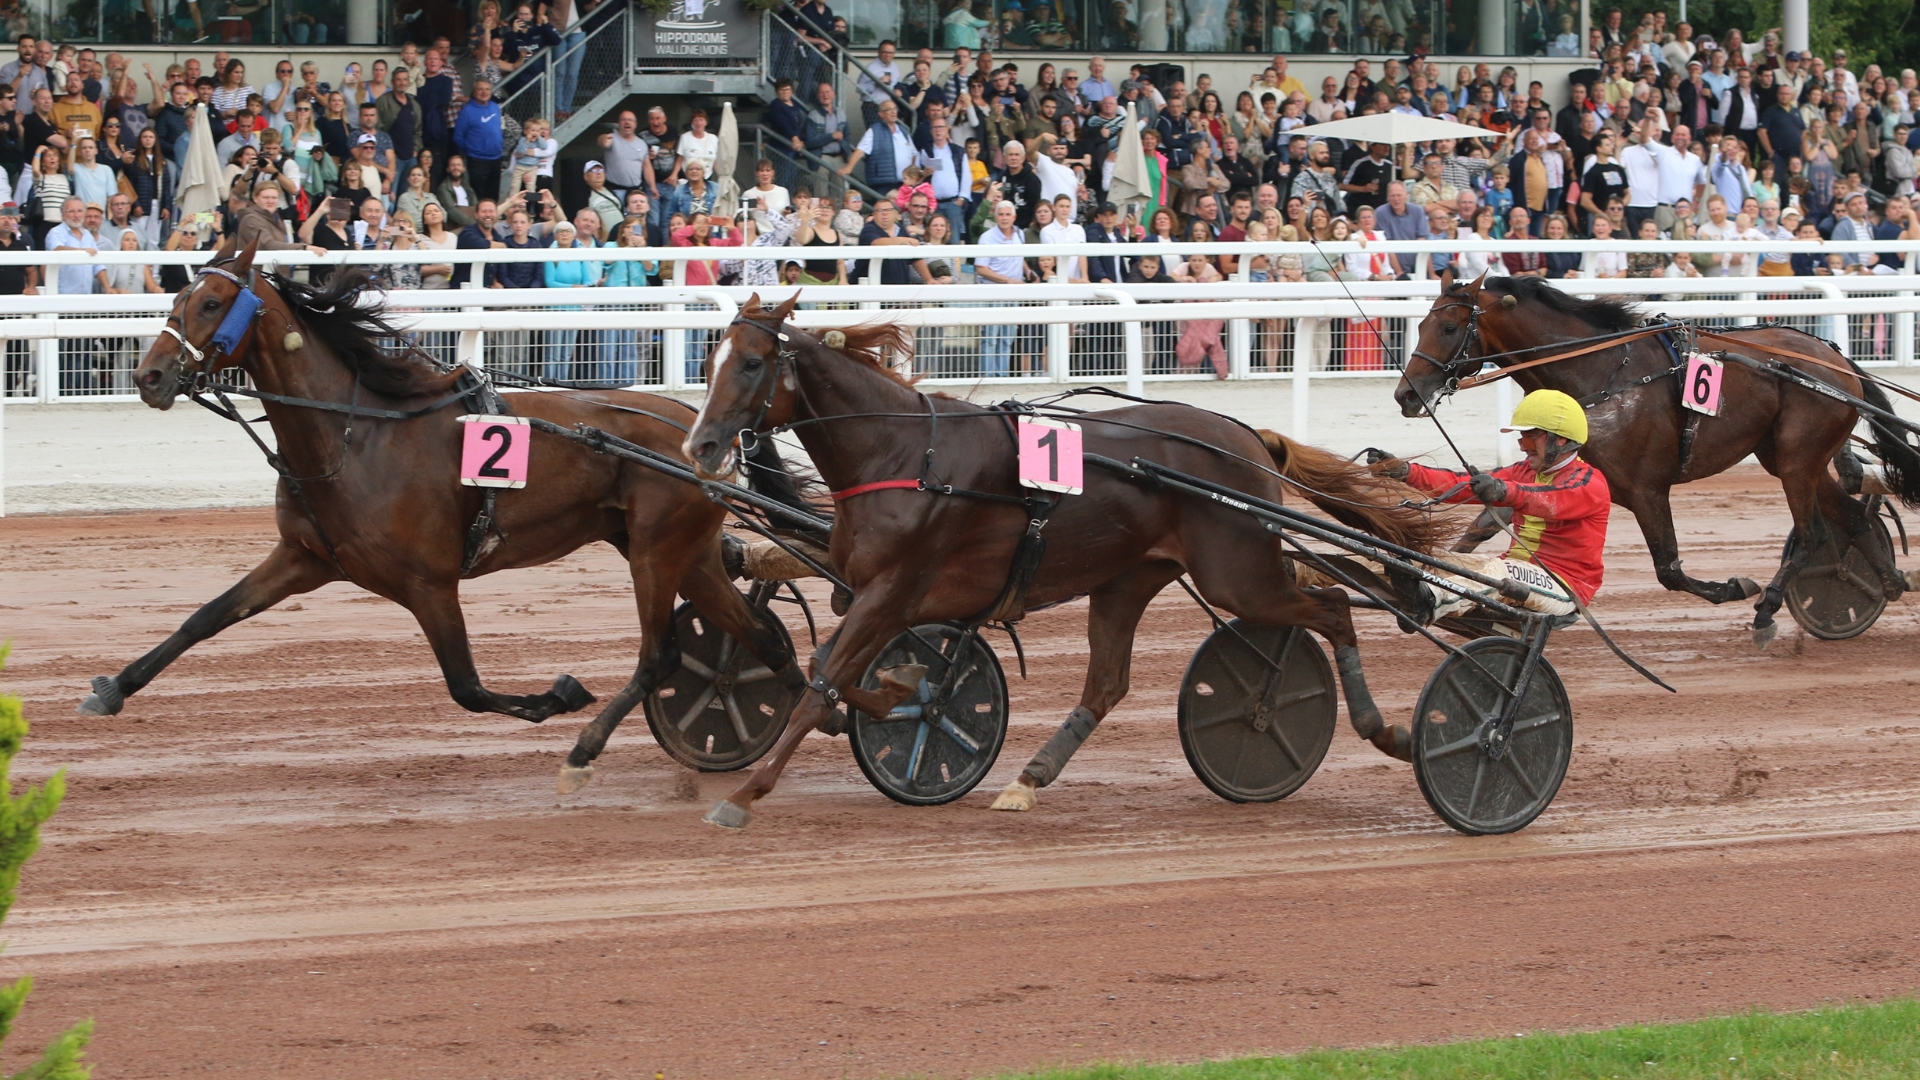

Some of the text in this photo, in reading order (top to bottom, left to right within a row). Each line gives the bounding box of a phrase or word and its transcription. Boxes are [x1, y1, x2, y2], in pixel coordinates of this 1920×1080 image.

[655, 32, 727, 44] HIPPODROME
[1694, 363, 1712, 405] 6
[478, 425, 512, 478] 2
[1037, 429, 1058, 482] 1
[1211, 492, 1249, 511] S. Ernault
[1422, 571, 1466, 594] YANKEE
